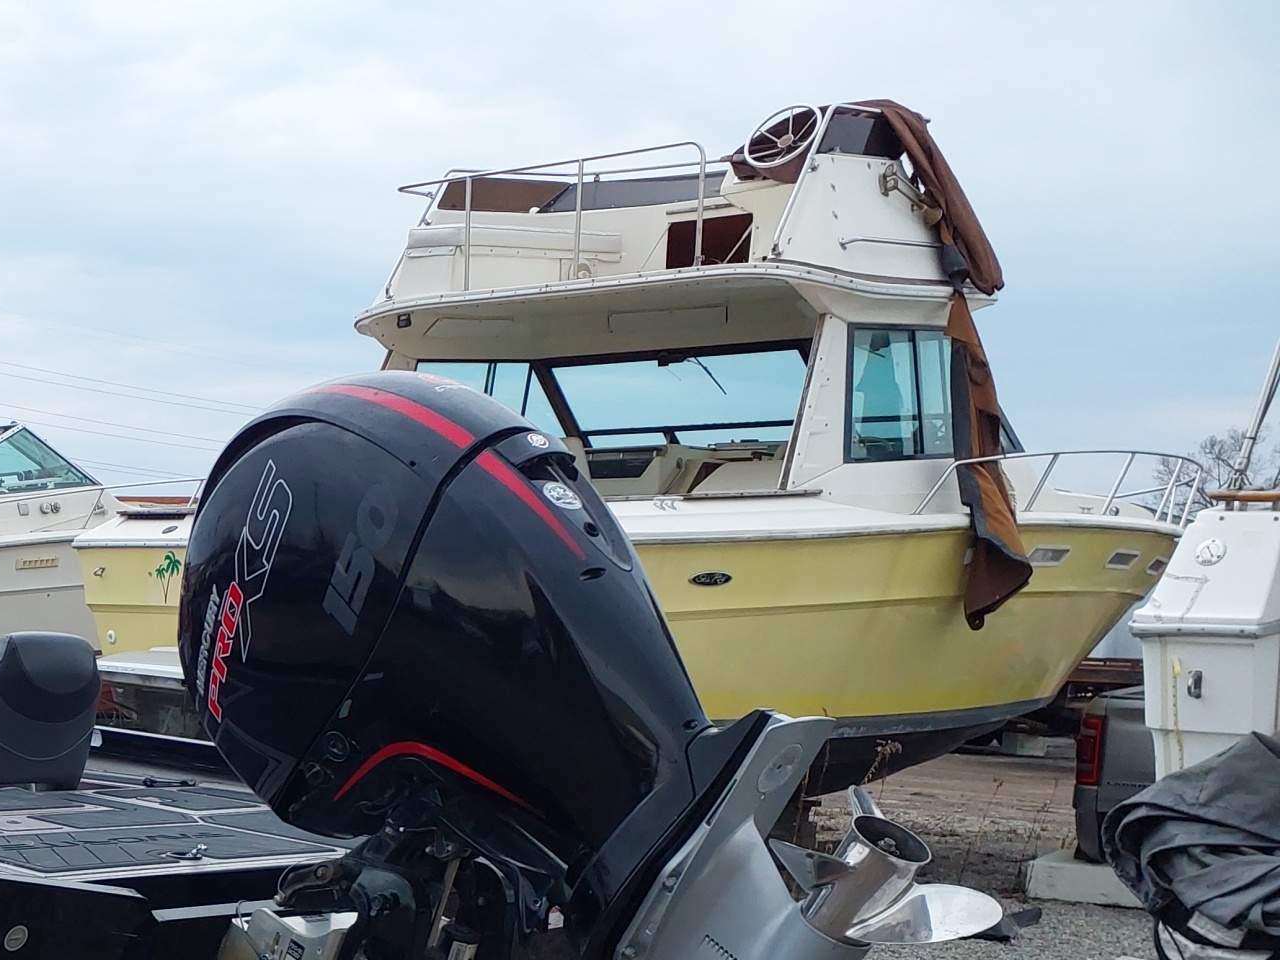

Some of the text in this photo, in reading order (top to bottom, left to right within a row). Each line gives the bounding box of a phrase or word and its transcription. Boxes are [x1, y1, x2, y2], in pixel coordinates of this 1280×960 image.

[208, 458, 293, 723] PRO XS
[322, 486, 400, 637] 150
[196, 583, 221, 711] MERCURY
